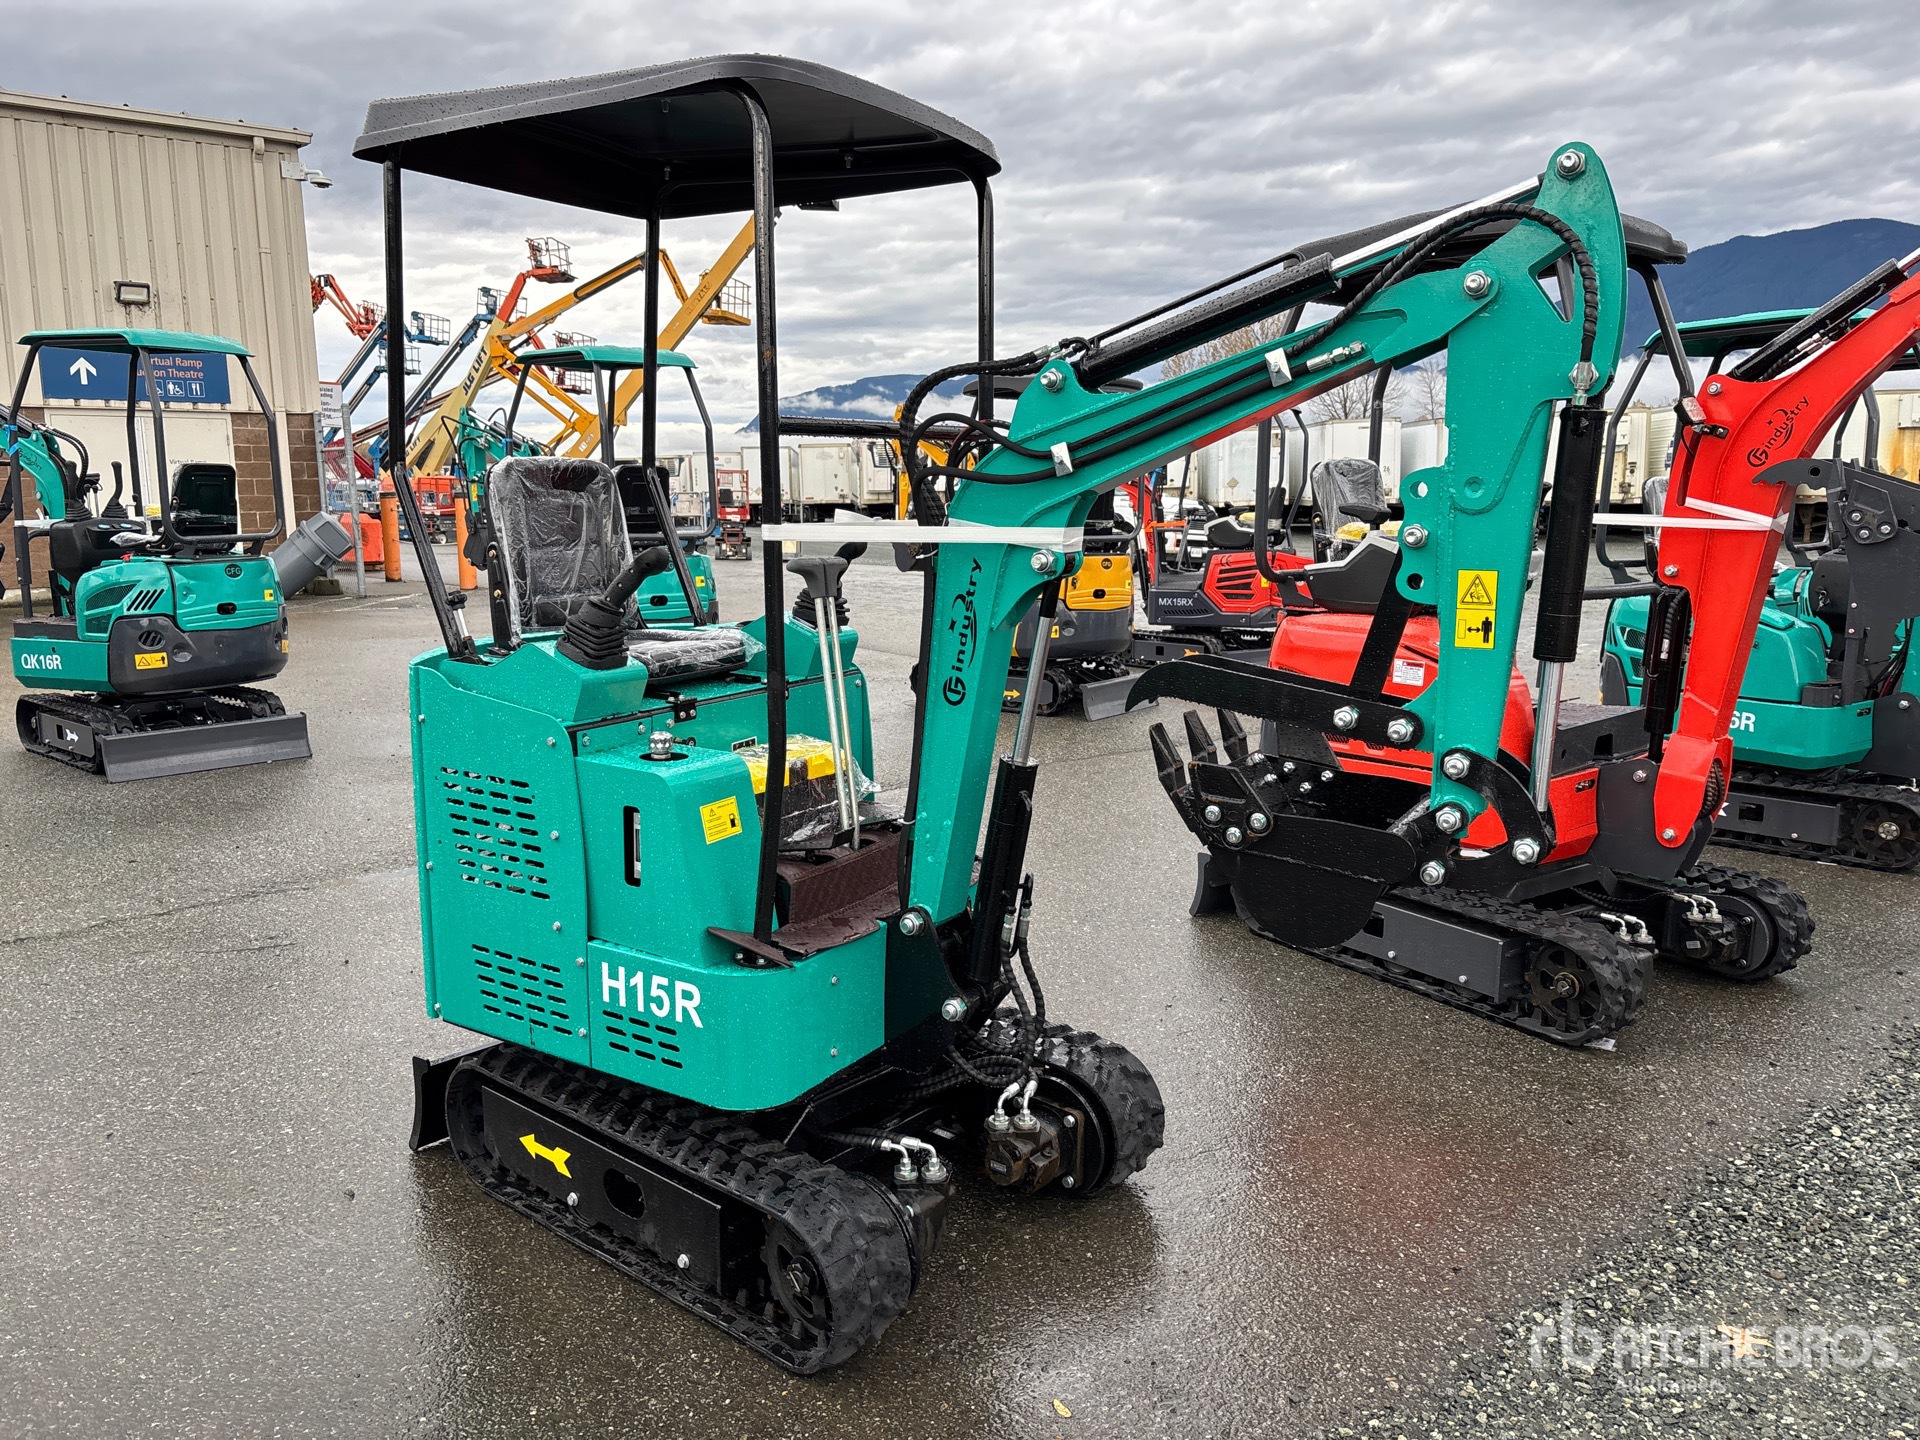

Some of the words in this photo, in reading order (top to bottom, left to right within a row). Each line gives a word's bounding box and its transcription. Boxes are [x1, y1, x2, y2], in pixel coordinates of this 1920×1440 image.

[150, 356, 173, 366] rtual
[175, 357, 203, 369] Ramp
[462, 374, 475, 396] JLG
[472, 345, 488, 374] LIFT
[167, 368, 204, 379] Theatre
[225, 566, 241, 575] CFG
[1158, 597, 1194, 607] MX15RX
[942, 556, 983, 707] Gindustry
[20, 653, 63, 670] QK16R
[1729, 710, 1757, 733] 6R
[601, 961, 704, 1029] H15R
